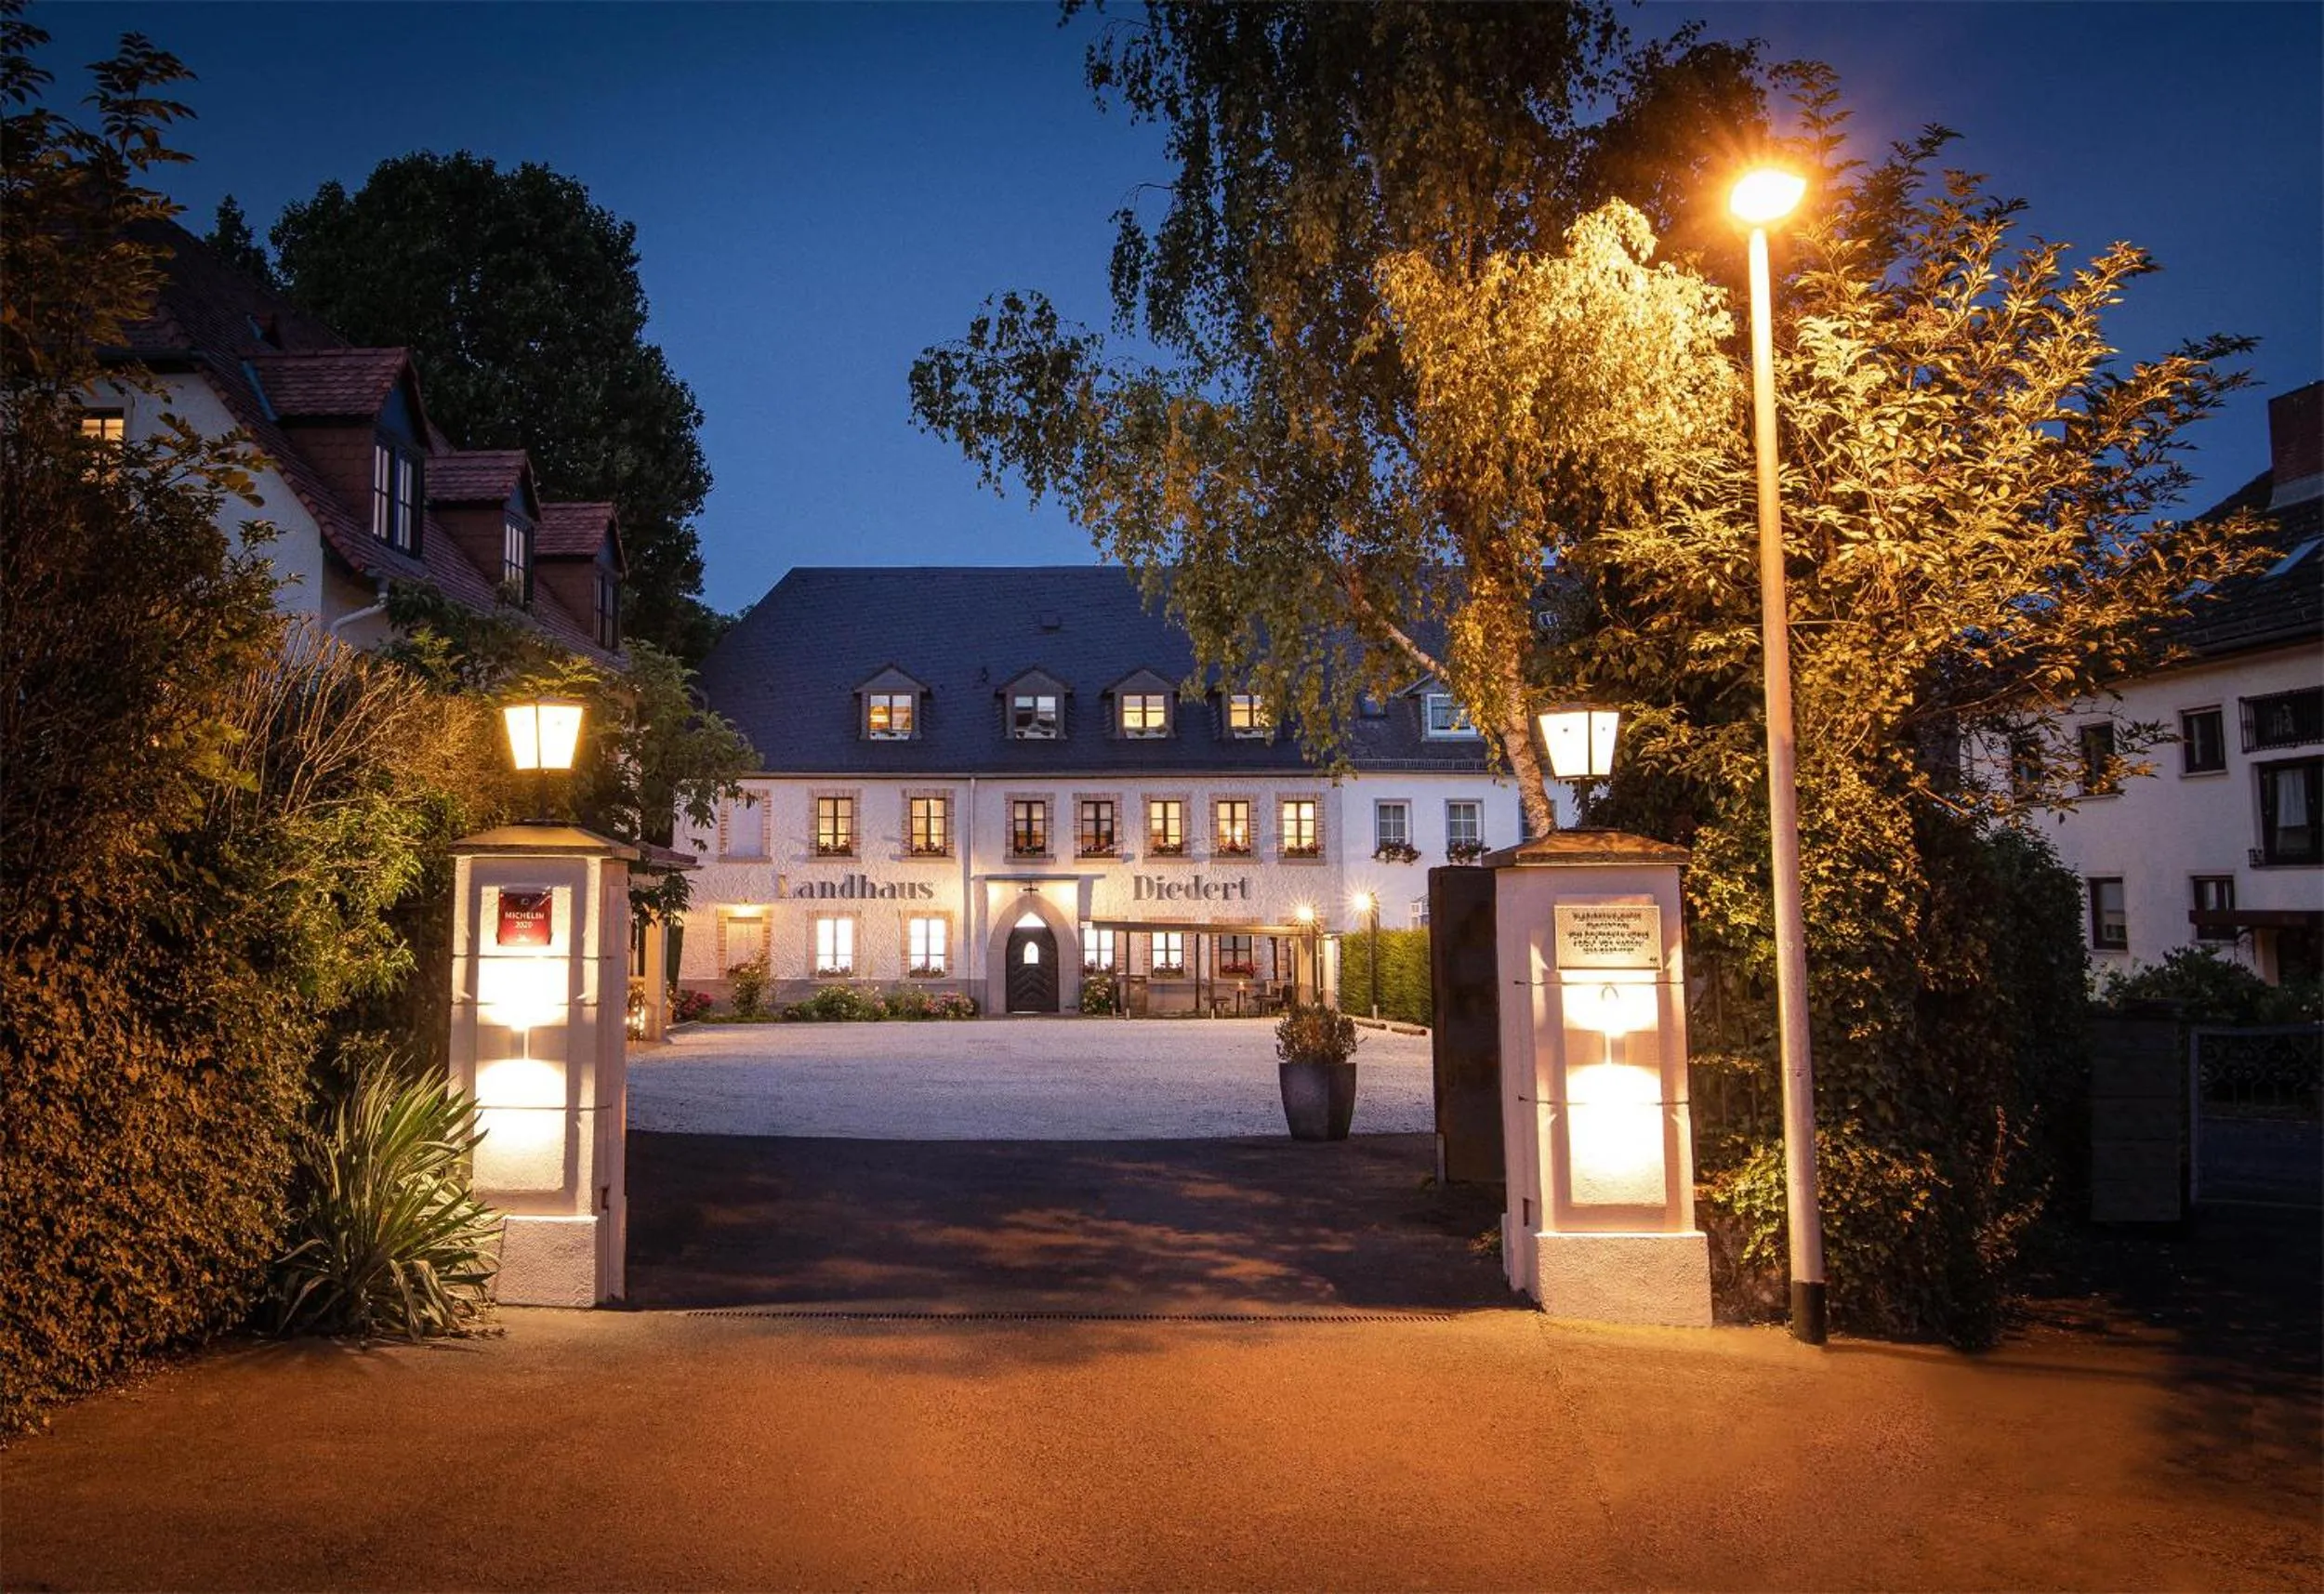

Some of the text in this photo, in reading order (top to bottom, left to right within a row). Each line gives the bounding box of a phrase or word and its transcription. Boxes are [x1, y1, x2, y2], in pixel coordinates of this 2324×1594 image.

[778, 875, 1251, 901] Landhaus Diedert
[505, 911, 545, 920] MICHELIN
